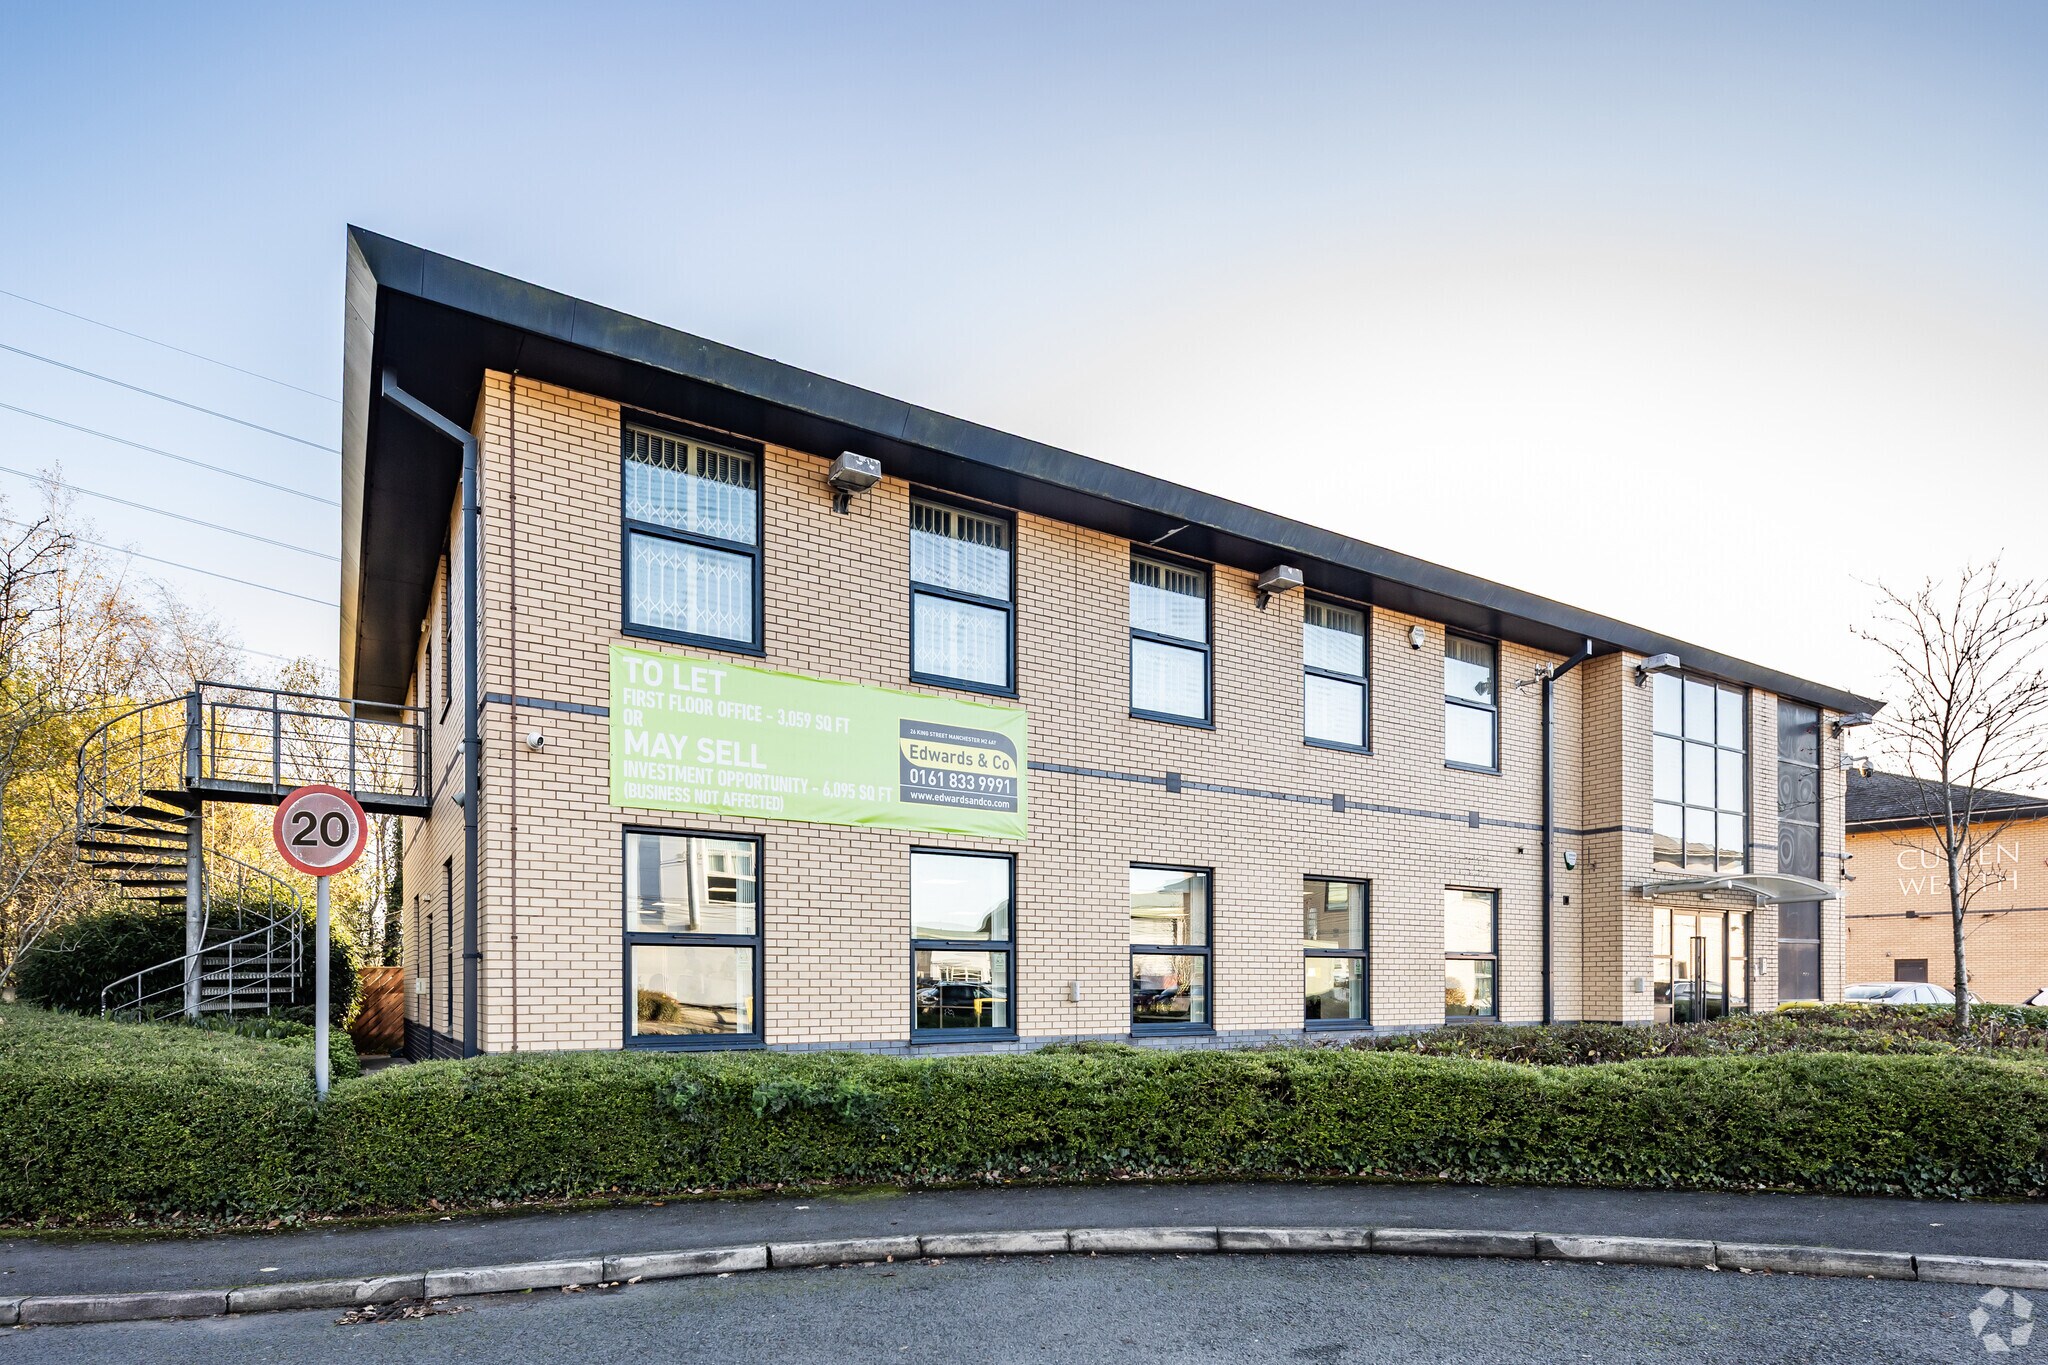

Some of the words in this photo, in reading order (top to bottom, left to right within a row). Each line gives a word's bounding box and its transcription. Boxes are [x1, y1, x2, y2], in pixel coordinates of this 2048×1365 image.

[622, 656, 663, 687] TO
[673, 663, 727, 696] LET
[623, 687, 664, 710] FIRST
[669, 693, 713, 717] FLOOR
[717, 700, 762, 723] OFFICE
[777, 708, 811, 729] 3,059
[815, 714, 832, 732] SQ
[835, 716, 850, 734] FT
[623, 708, 643, 727] OR
[624, 729, 688, 761] MAY
[696, 737, 767, 770] SELL
[929, 731, 948, 740] STREET
[948, 733, 980, 744] MANCHESTER
[909, 743, 973, 767] Edwards
[977, 752, 988, 770] &
[992, 754, 1010, 772] Co
[623, 760, 713, 785] INVESTMENT
[717, 769, 809, 795] OPPORTUNITY
[822, 780, 856, 800] 6,095
[859, 784, 875, 801] SQ
[878, 786, 893, 803] FT
[909, 768, 945, 787] 0161
[949, 774, 976, 791] 833
[978, 777, 1011, 795] 9991
[623, 782, 691, 804] (BUSINESS
[694, 788, 718, 806] NOT
[722, 791, 784, 813] AFFECTED)
[910, 790, 1010, 809] www.edwardsandco.com
[291, 811, 350, 847] 20
[1897, 842, 2019, 870] CULEN
